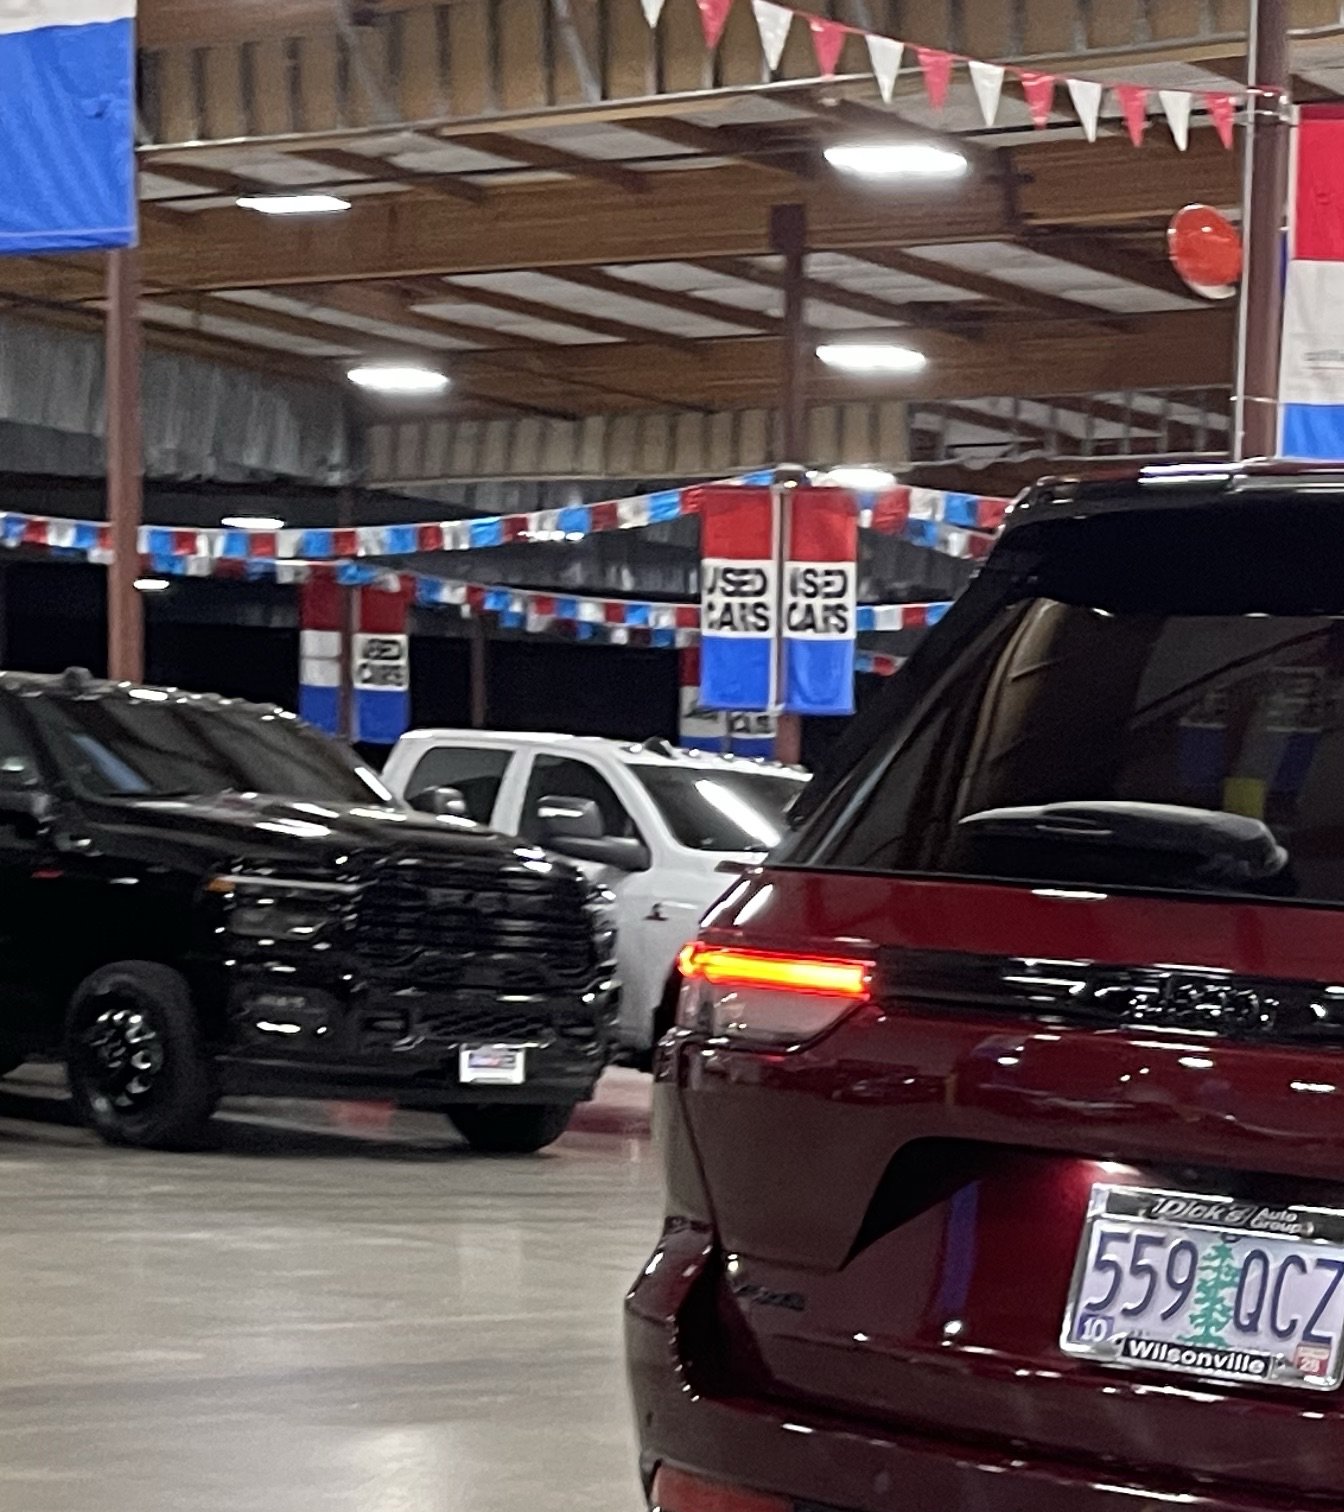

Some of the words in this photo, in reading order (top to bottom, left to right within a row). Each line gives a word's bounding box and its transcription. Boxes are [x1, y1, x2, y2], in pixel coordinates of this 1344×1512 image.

[1251, 1216, 1304, 1234] Group
[1254, 1207, 1298, 1222] Auto
[1084, 1230, 1200, 1321] 559
[1081, 1316, 1107, 1342] 10
[1128, 1338, 1265, 1375] Wilsonville
